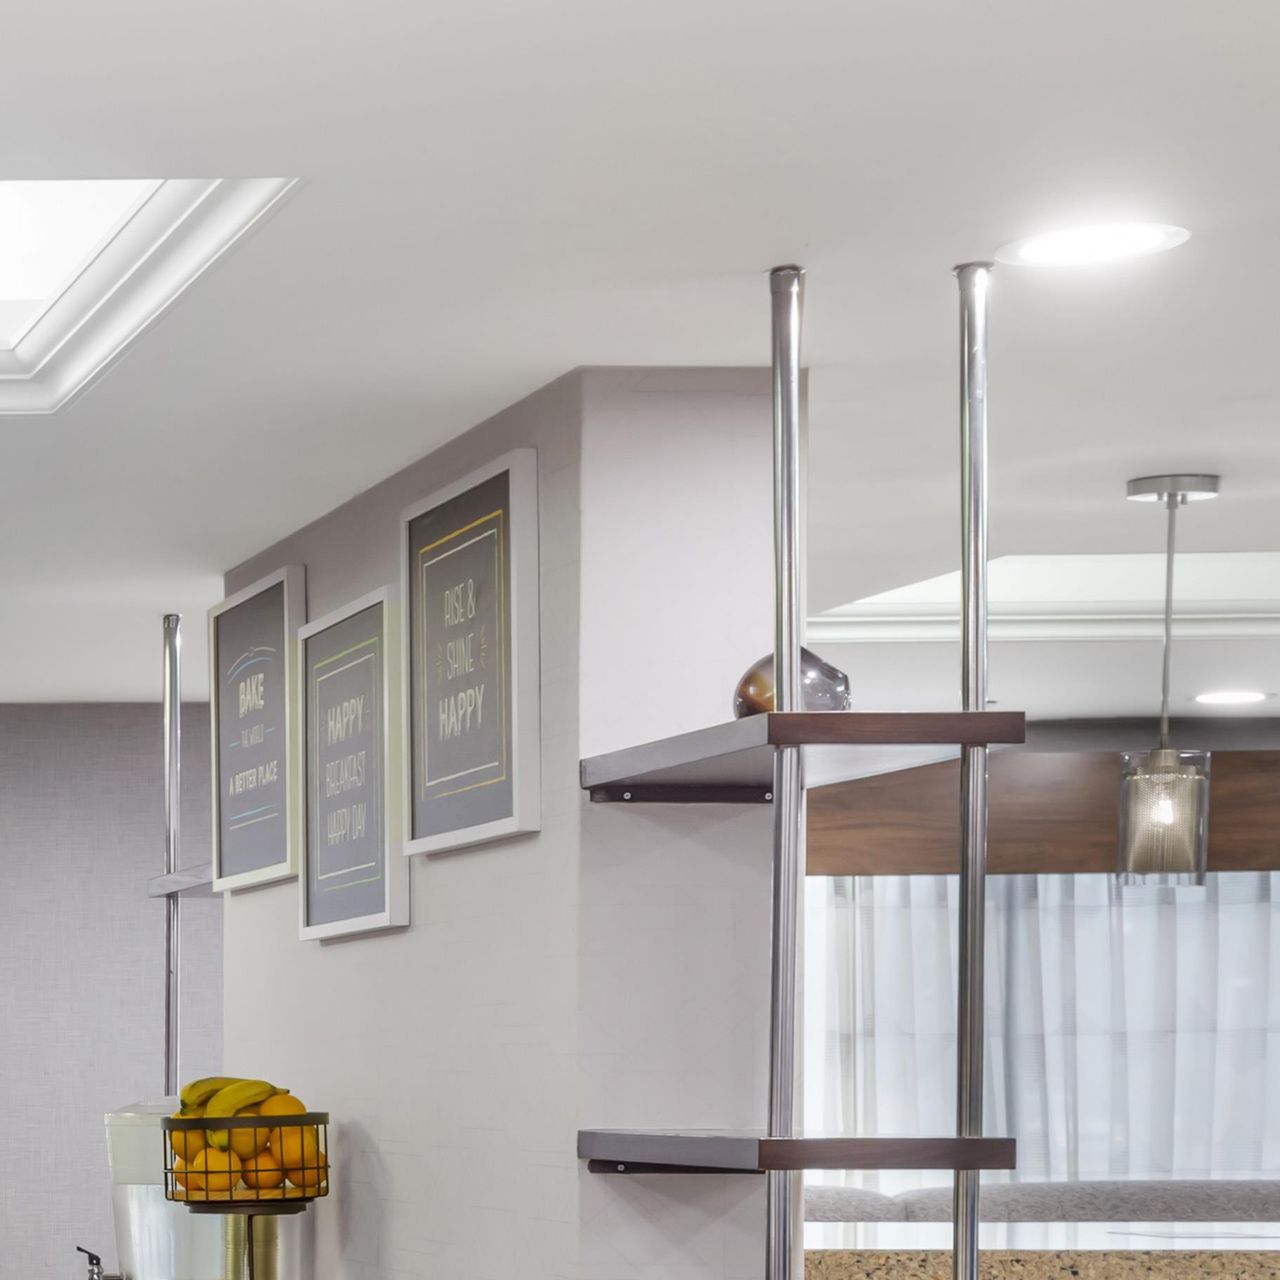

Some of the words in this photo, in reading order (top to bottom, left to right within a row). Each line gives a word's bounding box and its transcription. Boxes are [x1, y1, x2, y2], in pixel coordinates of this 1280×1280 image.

[444, 583, 465, 628] RISE
[467, 578, 476, 618] &
[446, 632, 474, 680] SHINE
[239, 672, 264, 719] BAKE
[439, 683, 484, 741] HAPPY
[327, 694, 364, 746] HAPPY
[235, 768, 257, 795] BETTER
[258, 760, 278, 787] PLACE
[326, 750, 366, 798] BREAKFAST
